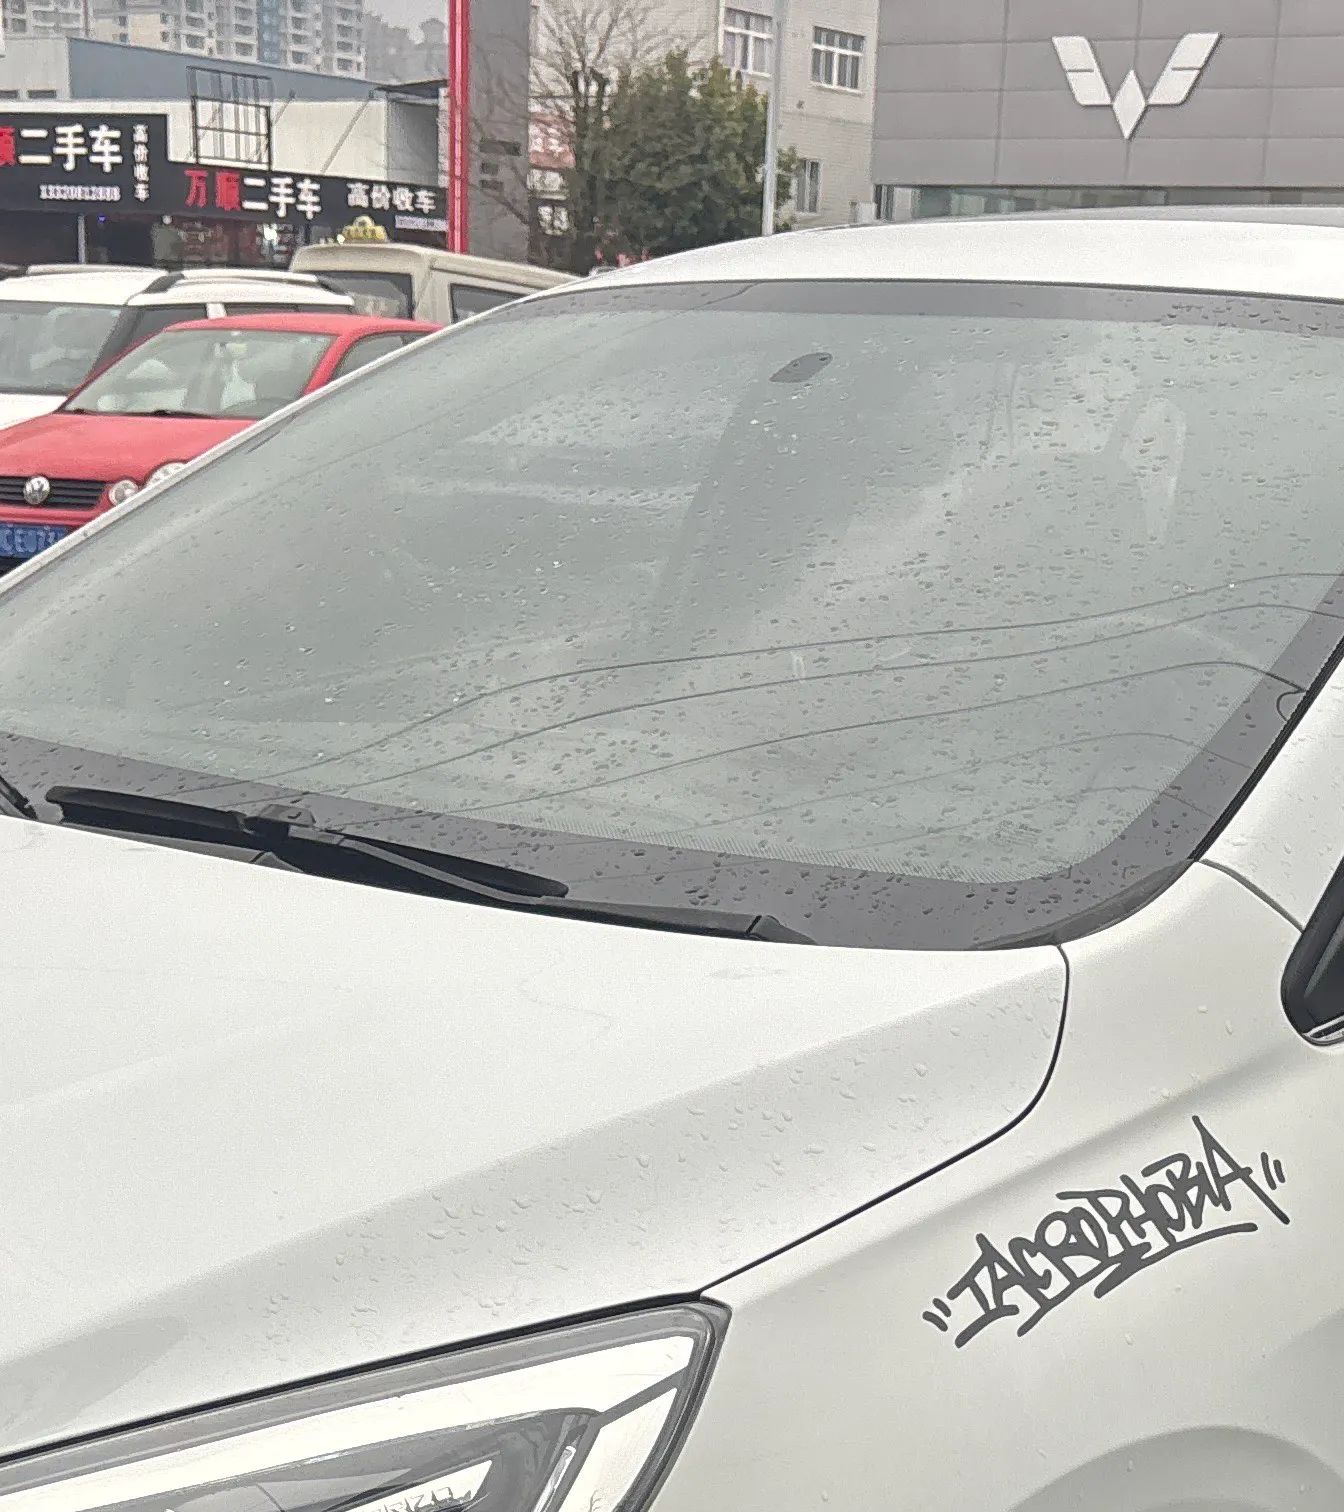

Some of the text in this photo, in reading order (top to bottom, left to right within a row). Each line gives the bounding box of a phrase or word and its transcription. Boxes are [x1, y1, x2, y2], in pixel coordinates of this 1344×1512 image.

[183, 170, 437, 220] 万顺二手车 高价收车
